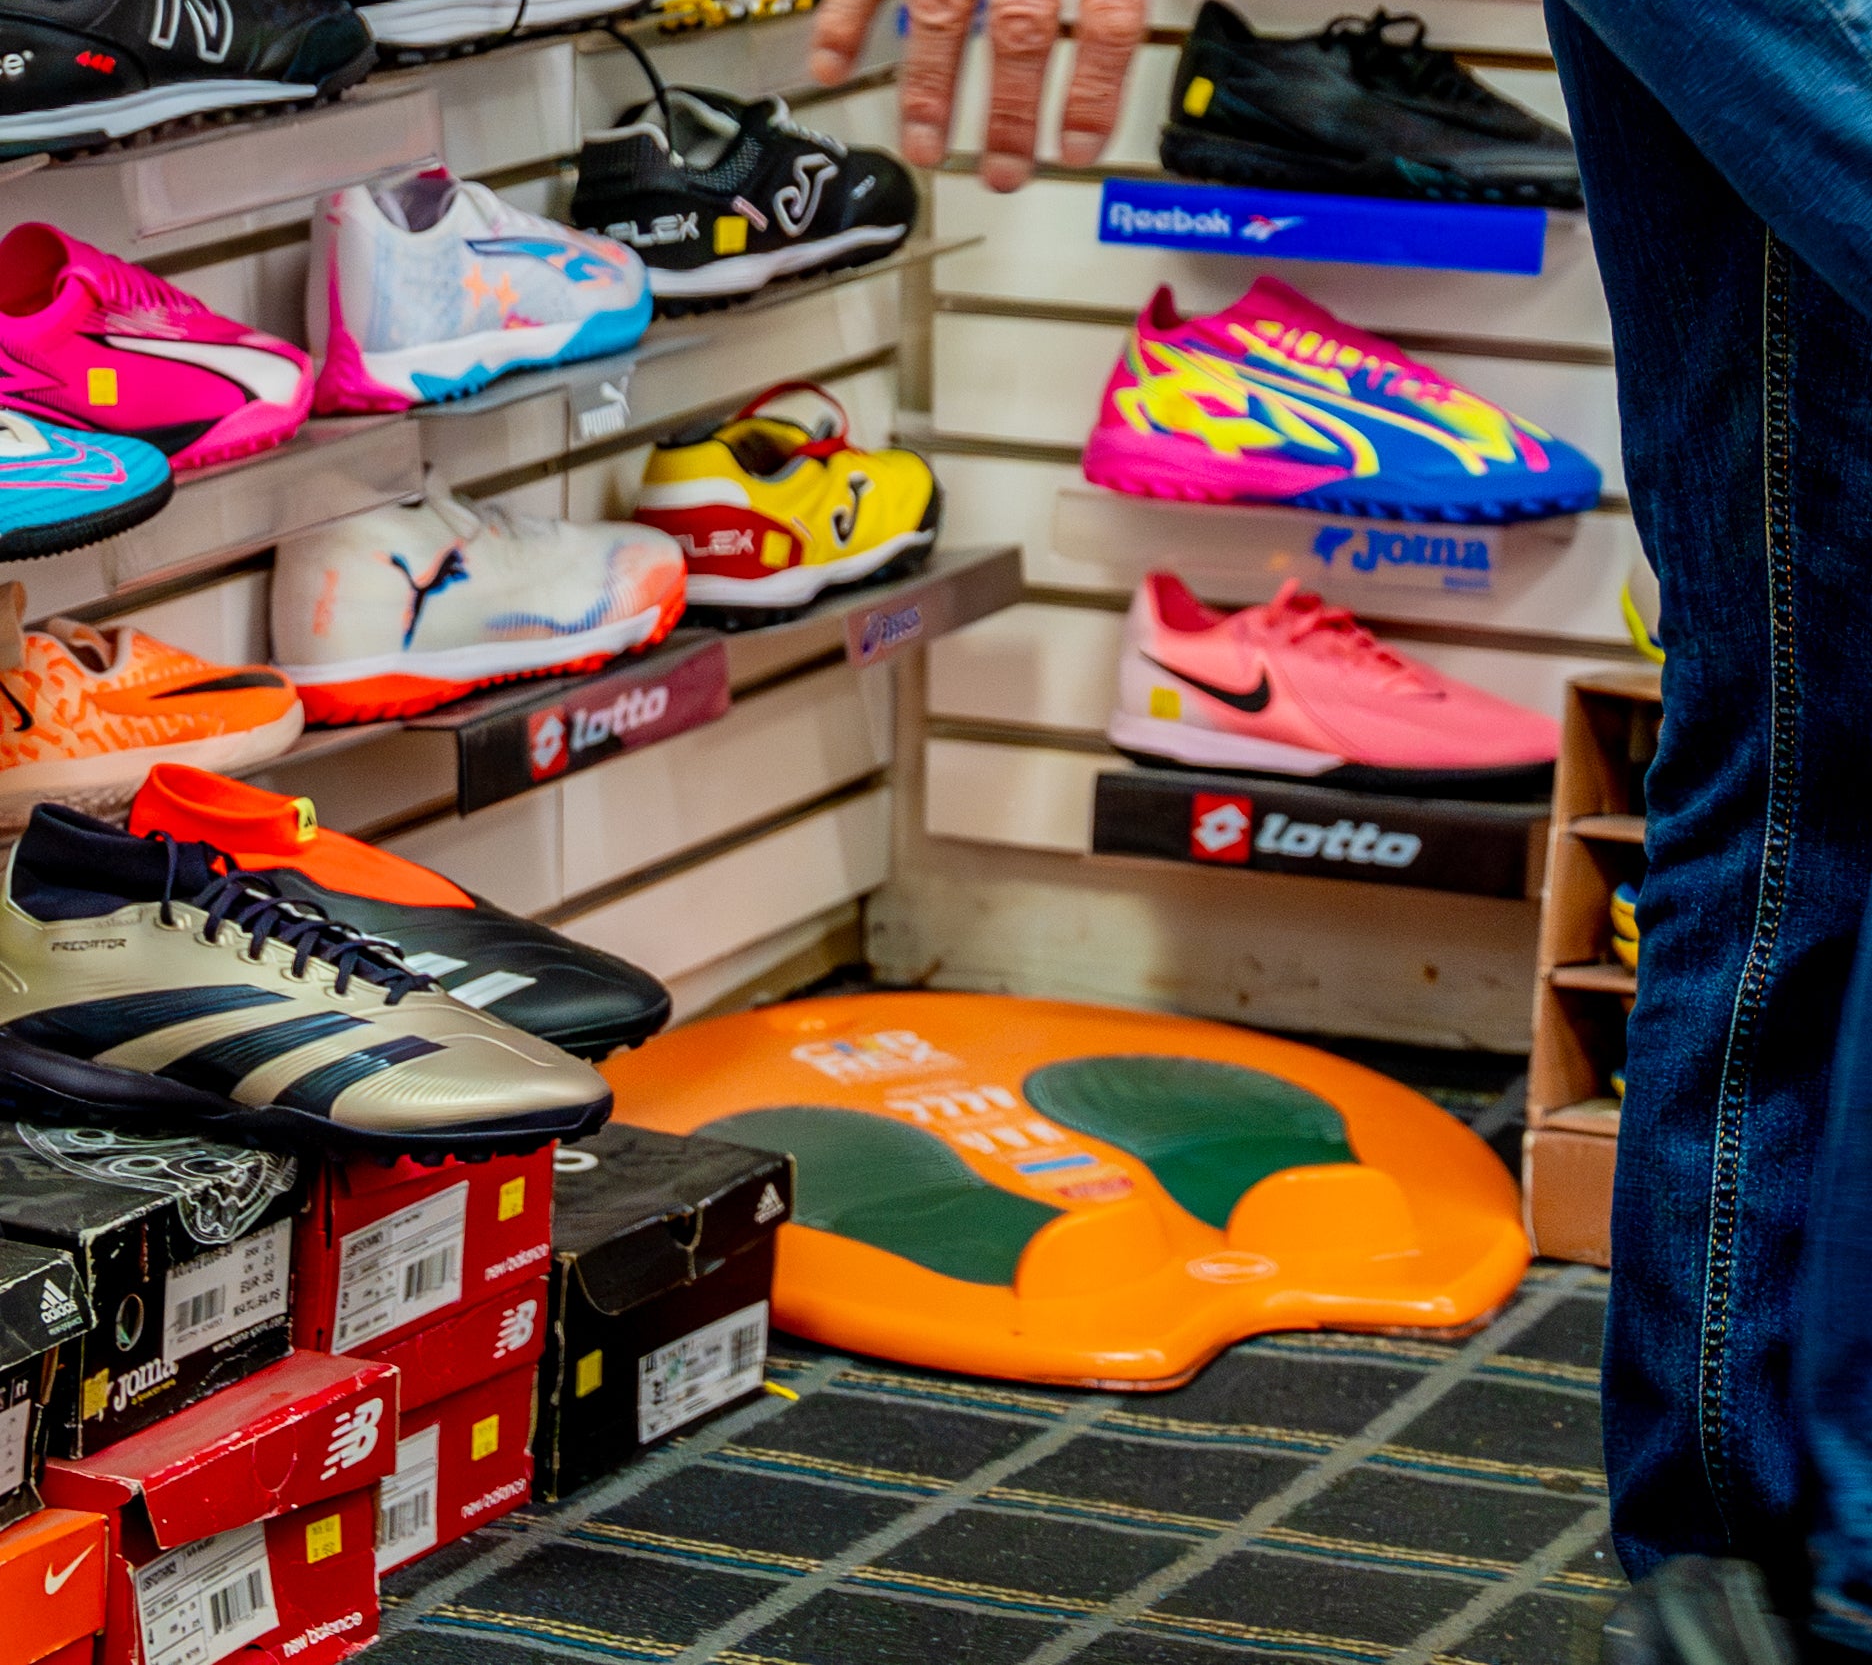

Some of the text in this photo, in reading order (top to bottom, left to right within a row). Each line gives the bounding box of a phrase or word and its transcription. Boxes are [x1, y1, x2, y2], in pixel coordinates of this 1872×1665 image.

[1108, 201, 1231, 238] Reebok
[1353, 529, 1491, 573] Joma
[570, 685, 669, 752] lotto
[1254, 813, 1423, 868] lotto
[41, 1301, 79, 1323] adidas
[113, 1359, 180, 1412] Joma
[283, 1610, 364, 1658] new balance
